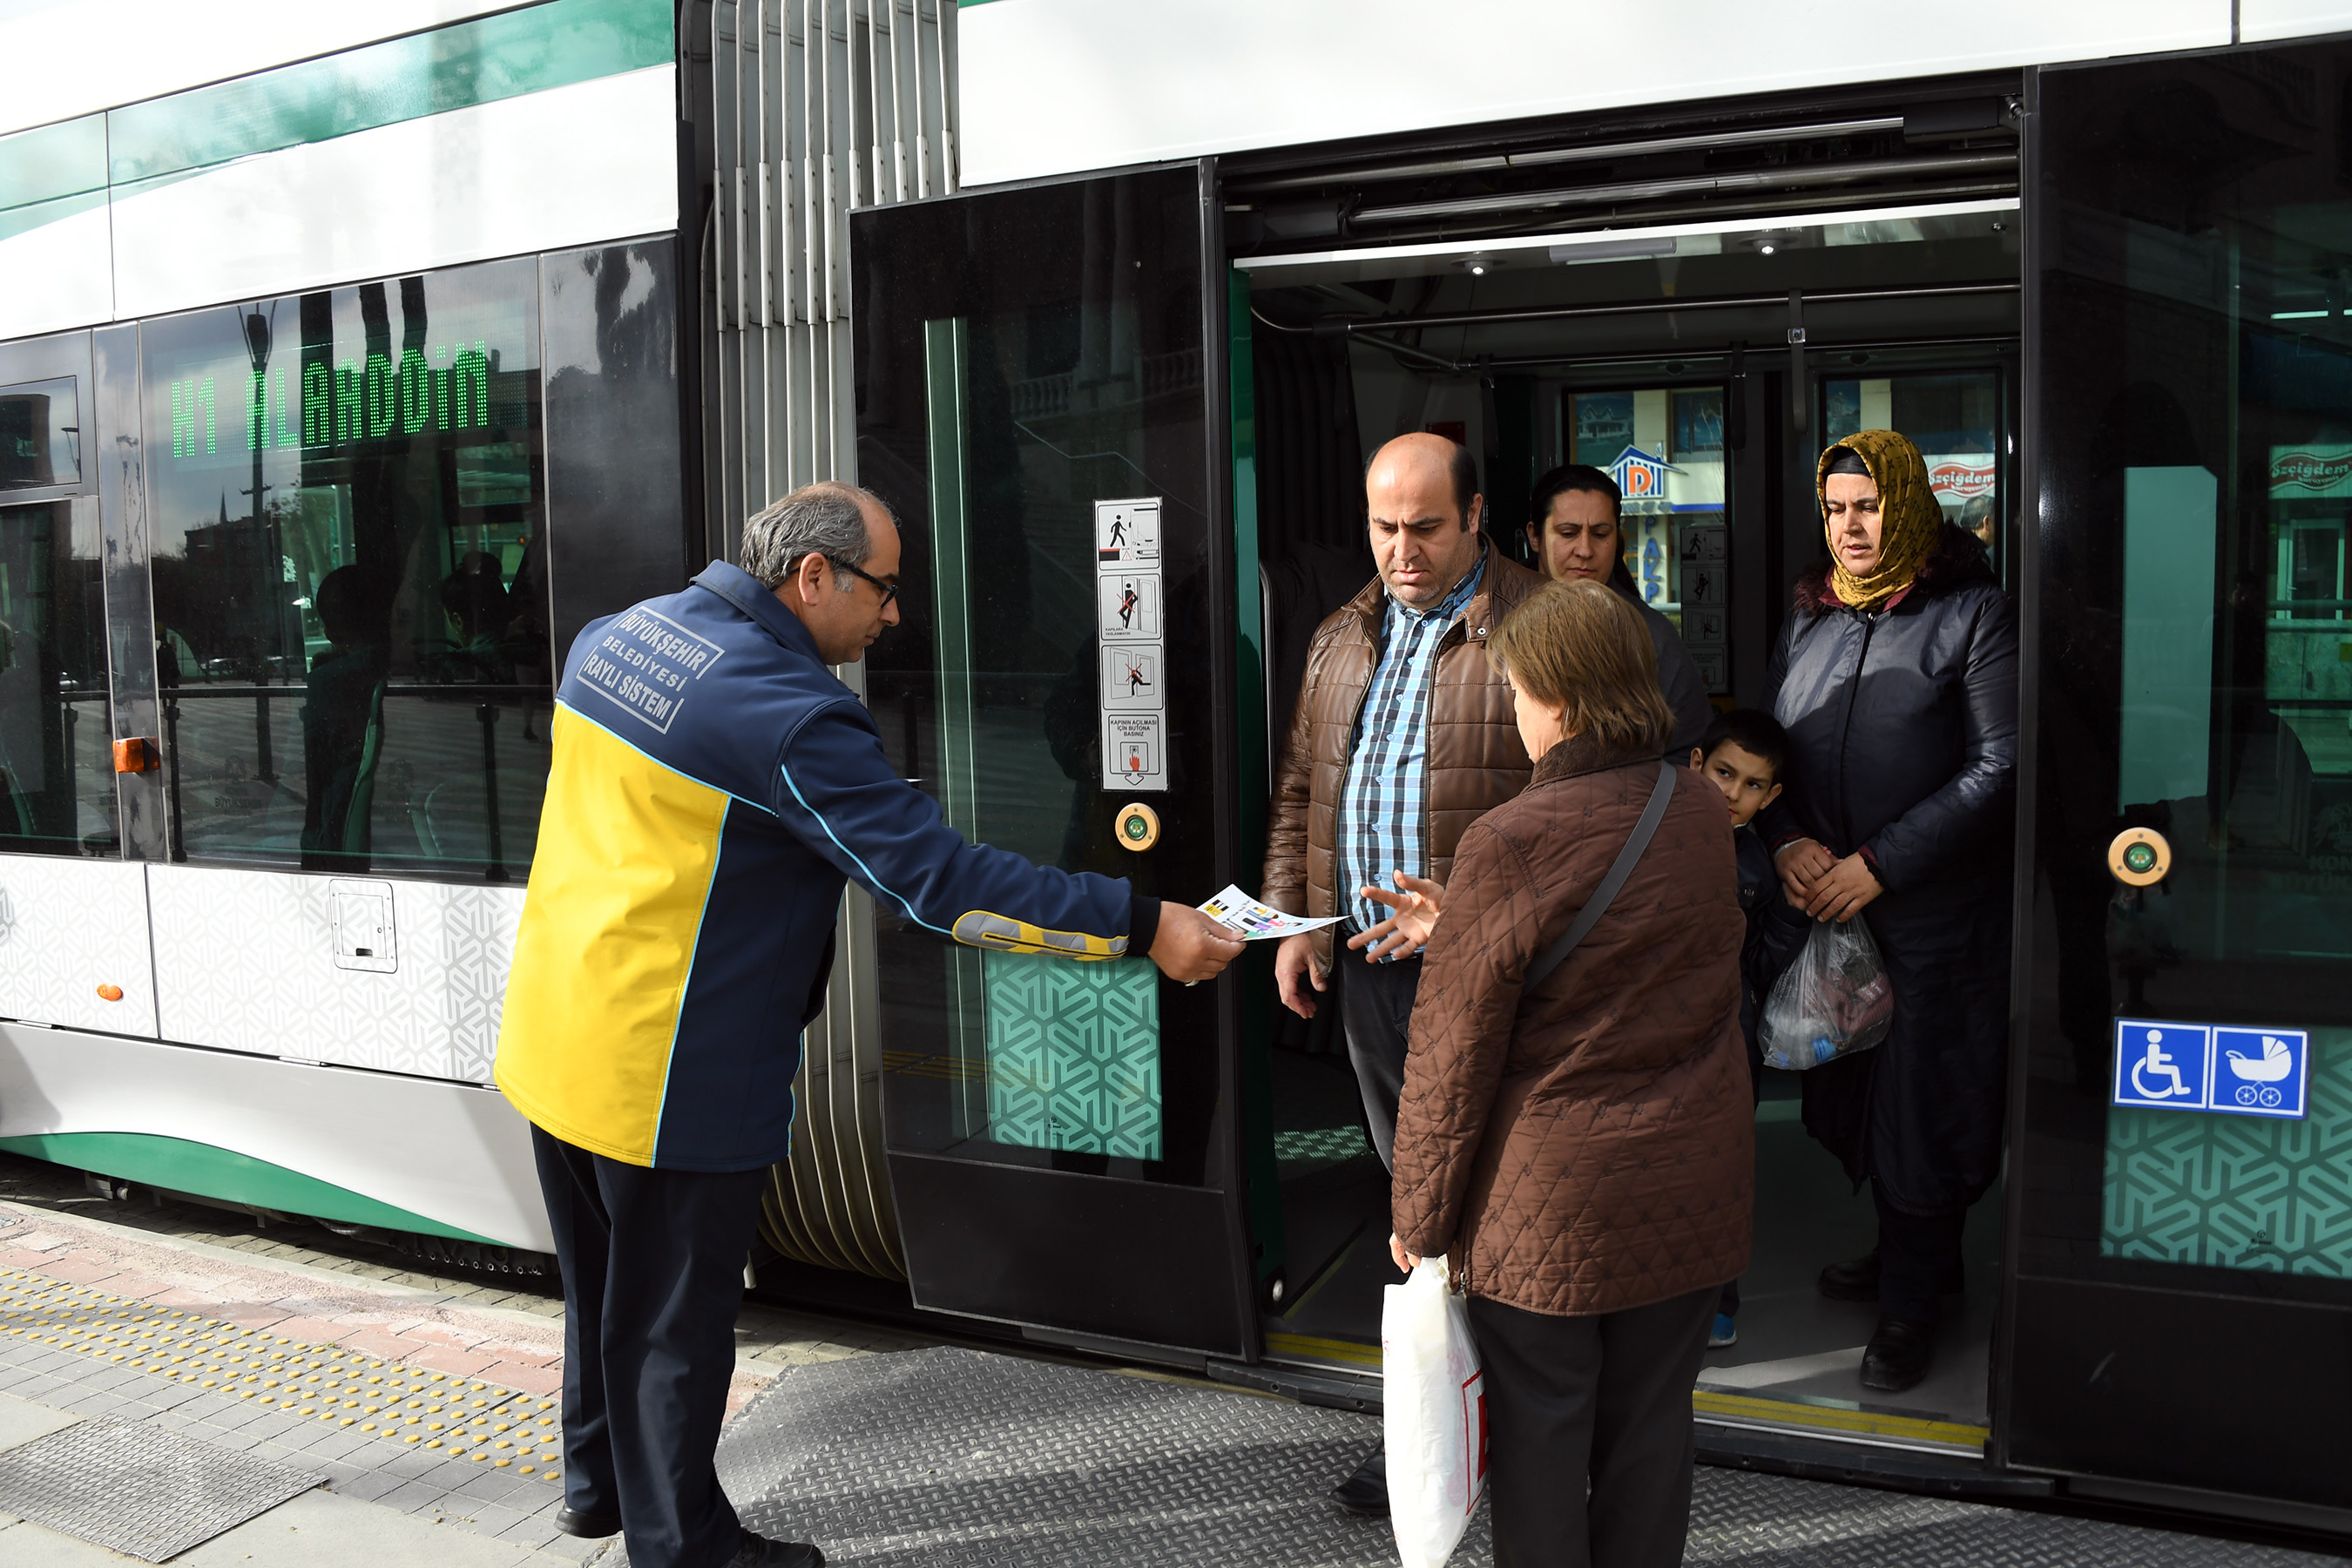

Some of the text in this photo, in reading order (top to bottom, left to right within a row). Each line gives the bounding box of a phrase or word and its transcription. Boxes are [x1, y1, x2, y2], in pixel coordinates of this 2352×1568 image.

[172, 376, 217, 458] H1
[602, 635, 688, 692] BELEDİYESİ
[619, 613, 707, 672] BÜYÜKŞEHİR
[584, 653, 672, 720] RAYLI SİSTEM
